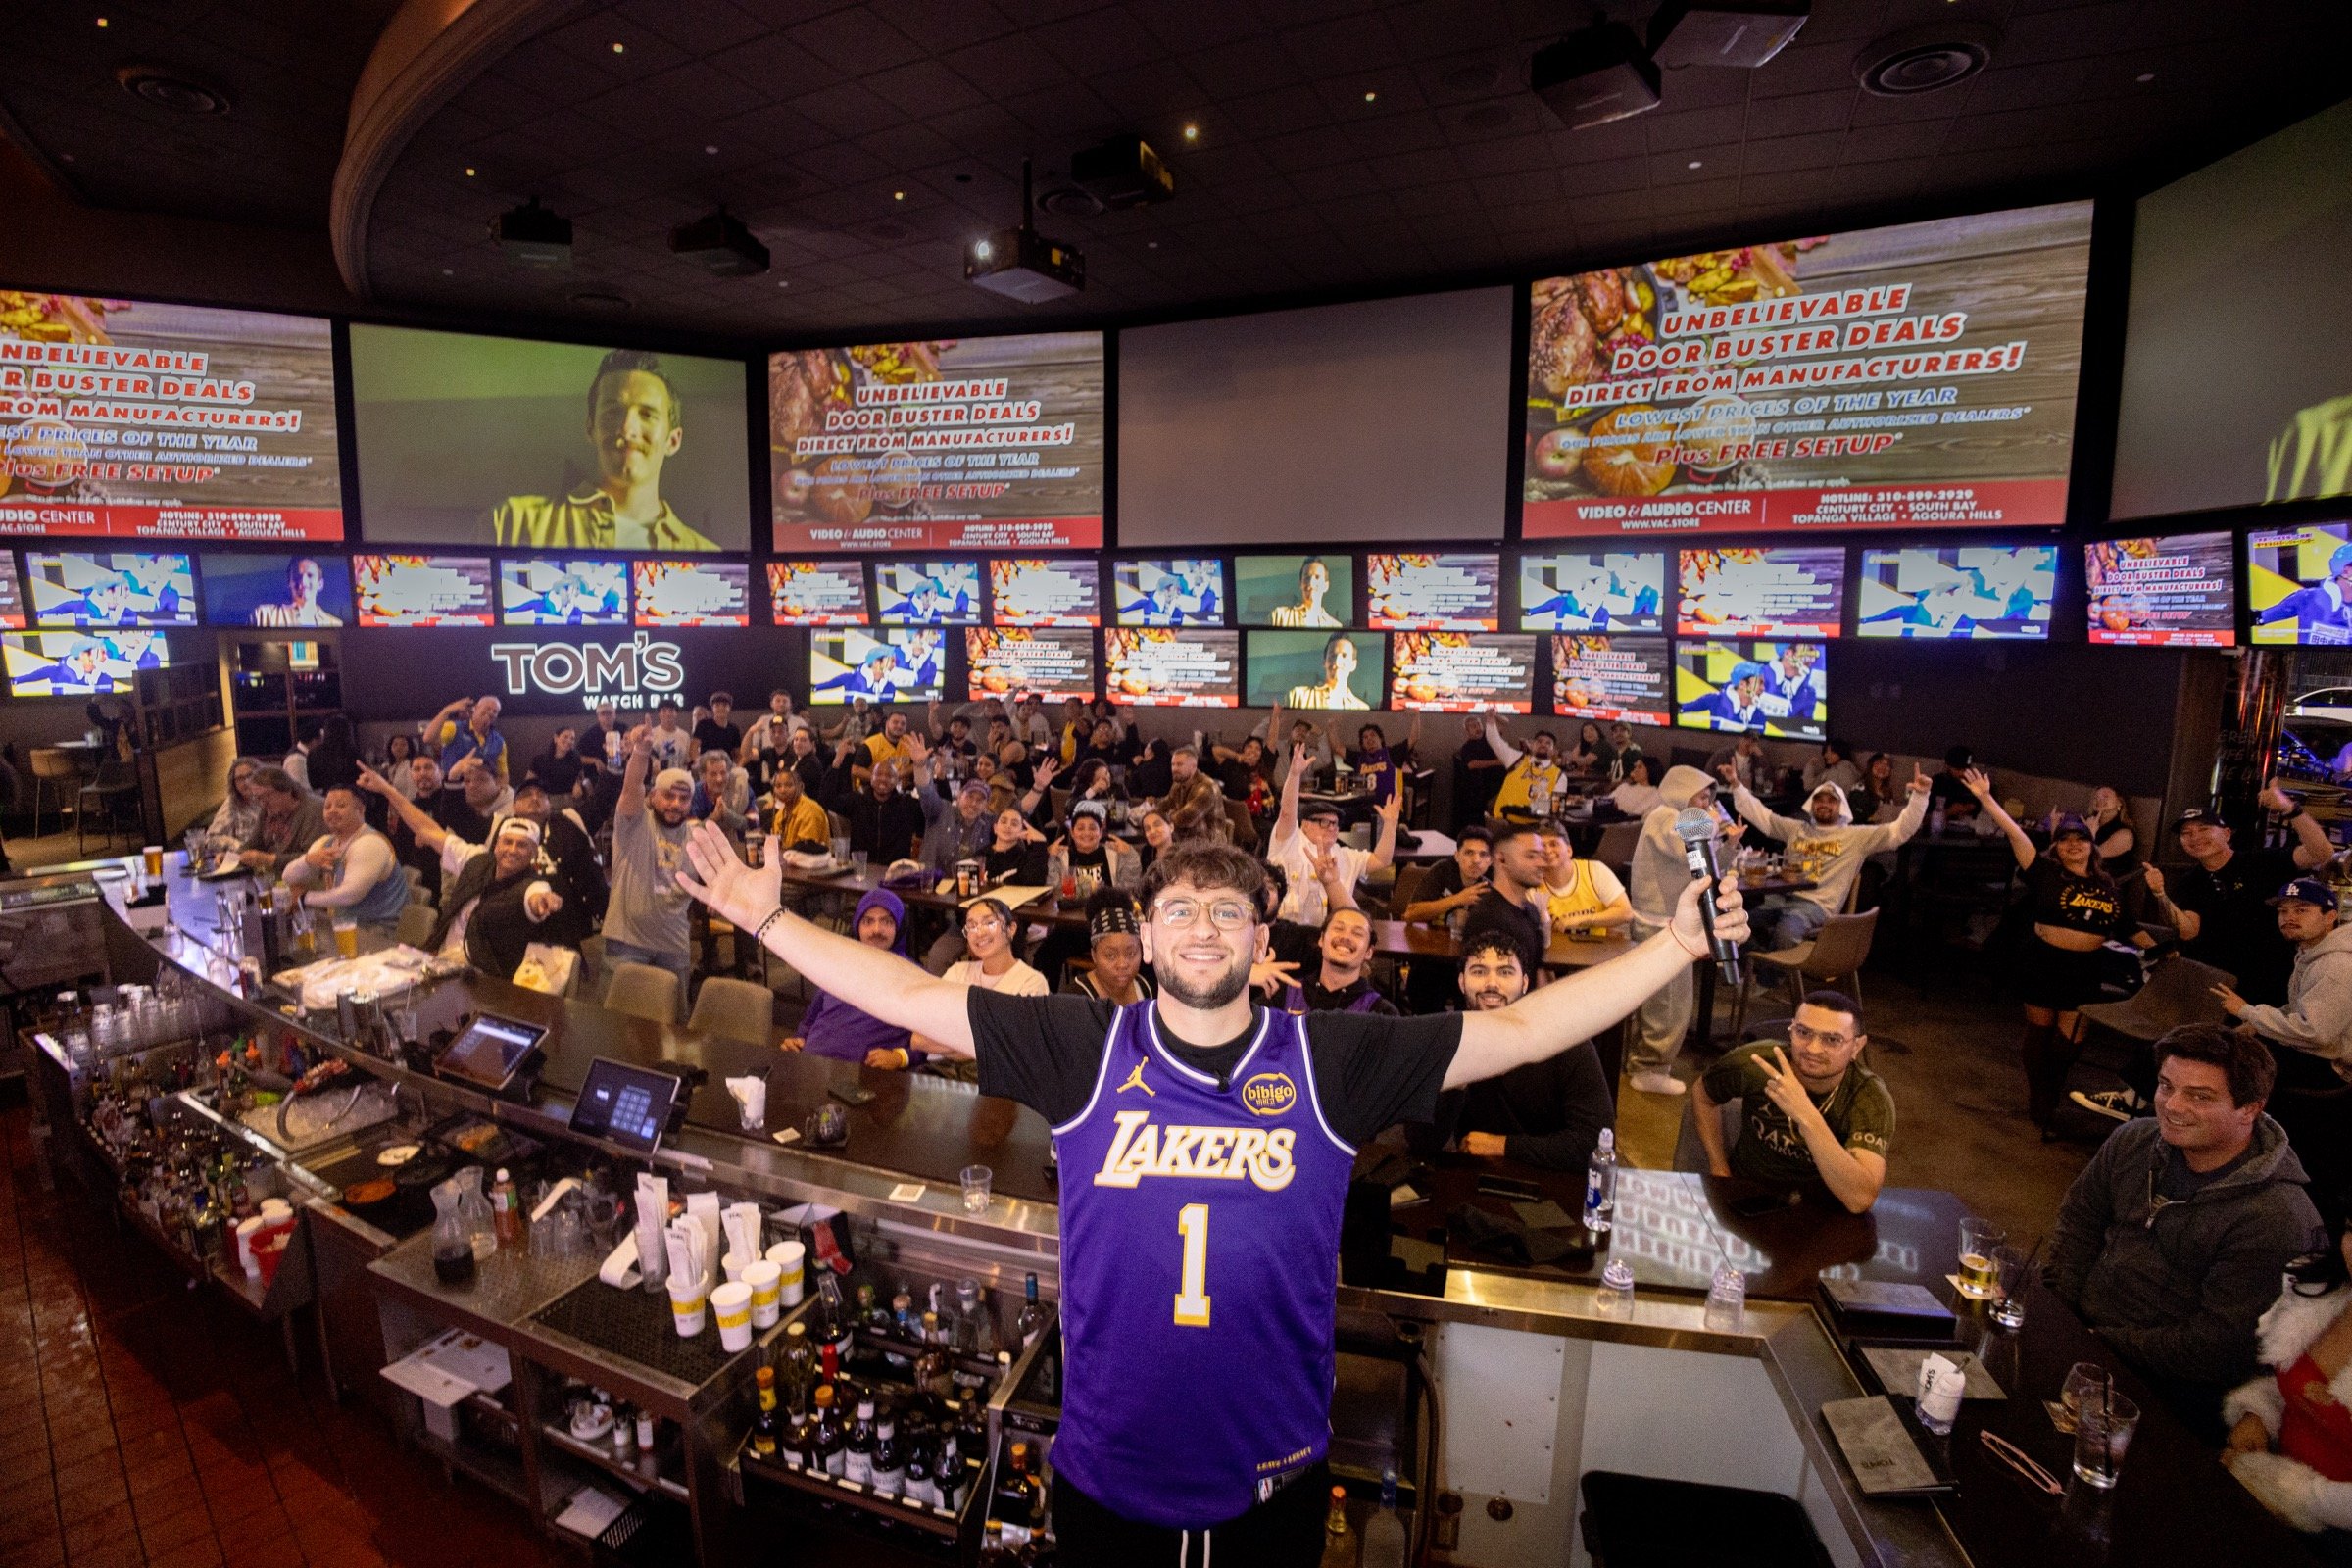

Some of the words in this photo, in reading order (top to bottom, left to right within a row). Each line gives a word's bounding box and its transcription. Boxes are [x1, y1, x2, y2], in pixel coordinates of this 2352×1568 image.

[1663, 285, 1908, 336] UNBELIEVABLE
[1614, 341, 1705, 372] DOOR
[1712, 325, 1837, 364] BUSTER
[1844, 314, 1965, 351] DEALS
[0, 342, 208, 374] NBELIEVABLE
[1567, 380, 1656, 406] DIRECT
[1657, 370, 1736, 398] FROM
[1740, 343, 2025, 391] MANUFACTURERS!
[34, 371, 152, 396] BUSTER
[160, 379, 255, 403] DEALS
[857, 379, 1006, 405] UNBELIEVABLE
[0, 398, 61, 418] ROM
[67, 401, 301, 430] MANUFACTURERS!
[827, 410, 885, 429] DOOR
[890, 405, 966, 426] BUSTER
[971, 401, 1039, 422] DEALS
[1616, 406, 1703, 428] LOWEST
[1707, 398, 1789, 420] PRICES
[1794, 396, 1830, 415] OF
[1834, 392, 1881, 412] THE
[1887, 387, 1958, 409] YEAR
[1773, 418, 1825, 433] OTHER
[1828, 412, 1938, 431] AUTHORIZED
[38, 428, 116, 445] PRICES
[122, 432, 153, 447] OF
[157, 432, 199, 448] THE
[202, 434, 258, 452] YEAR
[797, 436, 856, 453] DIRECT
[858, 433, 906, 450] FROM
[911, 424, 1074, 449] MANUFACTURERS!
[830, 458, 888, 471] LOWEST
[944, 454, 965, 467] OF
[968, 453, 995, 466] THE
[1000, 452, 1040, 466] YEAR
[1654, 445, 1710, 465] Plus
[1717, 438, 1788, 462] FREE
[54, 462, 122, 481] FREE
[899, 484, 941, 500] FREE
[1821, 492, 1873, 504] HOTLINE:
[0, 508, 38, 523] UDIO
[40, 510, 95, 524] CENTER
[1578, 505, 1626, 520] VIDEO
[1641, 502, 1693, 517] AUDIO
[1695, 499, 1751, 515] CENTER
[1792, 513, 1848, 524] TOPANGA
[1850, 512, 1897, 523] VILLAGE
[1912, 510, 1965, 521] AGOURA
[1969, 509, 2003, 520] HILLS
[1816, 503, 1866, 514] CENTURY
[1869, 502, 1893, 513] CITY
[1908, 501, 1950, 513] SOUTH
[1952, 500, 1978, 511] BAY
[810, 528, 843, 540] VIDEO
[852, 528, 887, 539] AUDIO
[888, 527, 923, 539] CENTER
[1622, 517, 1700, 529] WWW.VAC.STORE
[2121, 556, 2188, 569] UNBELIEVABLE
[2135, 569, 2171, 580] BUSTER
[2173, 567, 2205, 578] DEALS
[491, 630, 684, 694] TOM'S
[583, 695, 643, 710] WATCH
[651, 693, 684, 708] BR
[2069, 893, 2113, 913] LAKERS
[1248, 1084, 1293, 1102] bibigo
[1094, 1110, 1297, 1192] LAKERS
[1853, 1132, 1887, 1151] GOAT
[1174, 1202, 1211, 1328] 1
